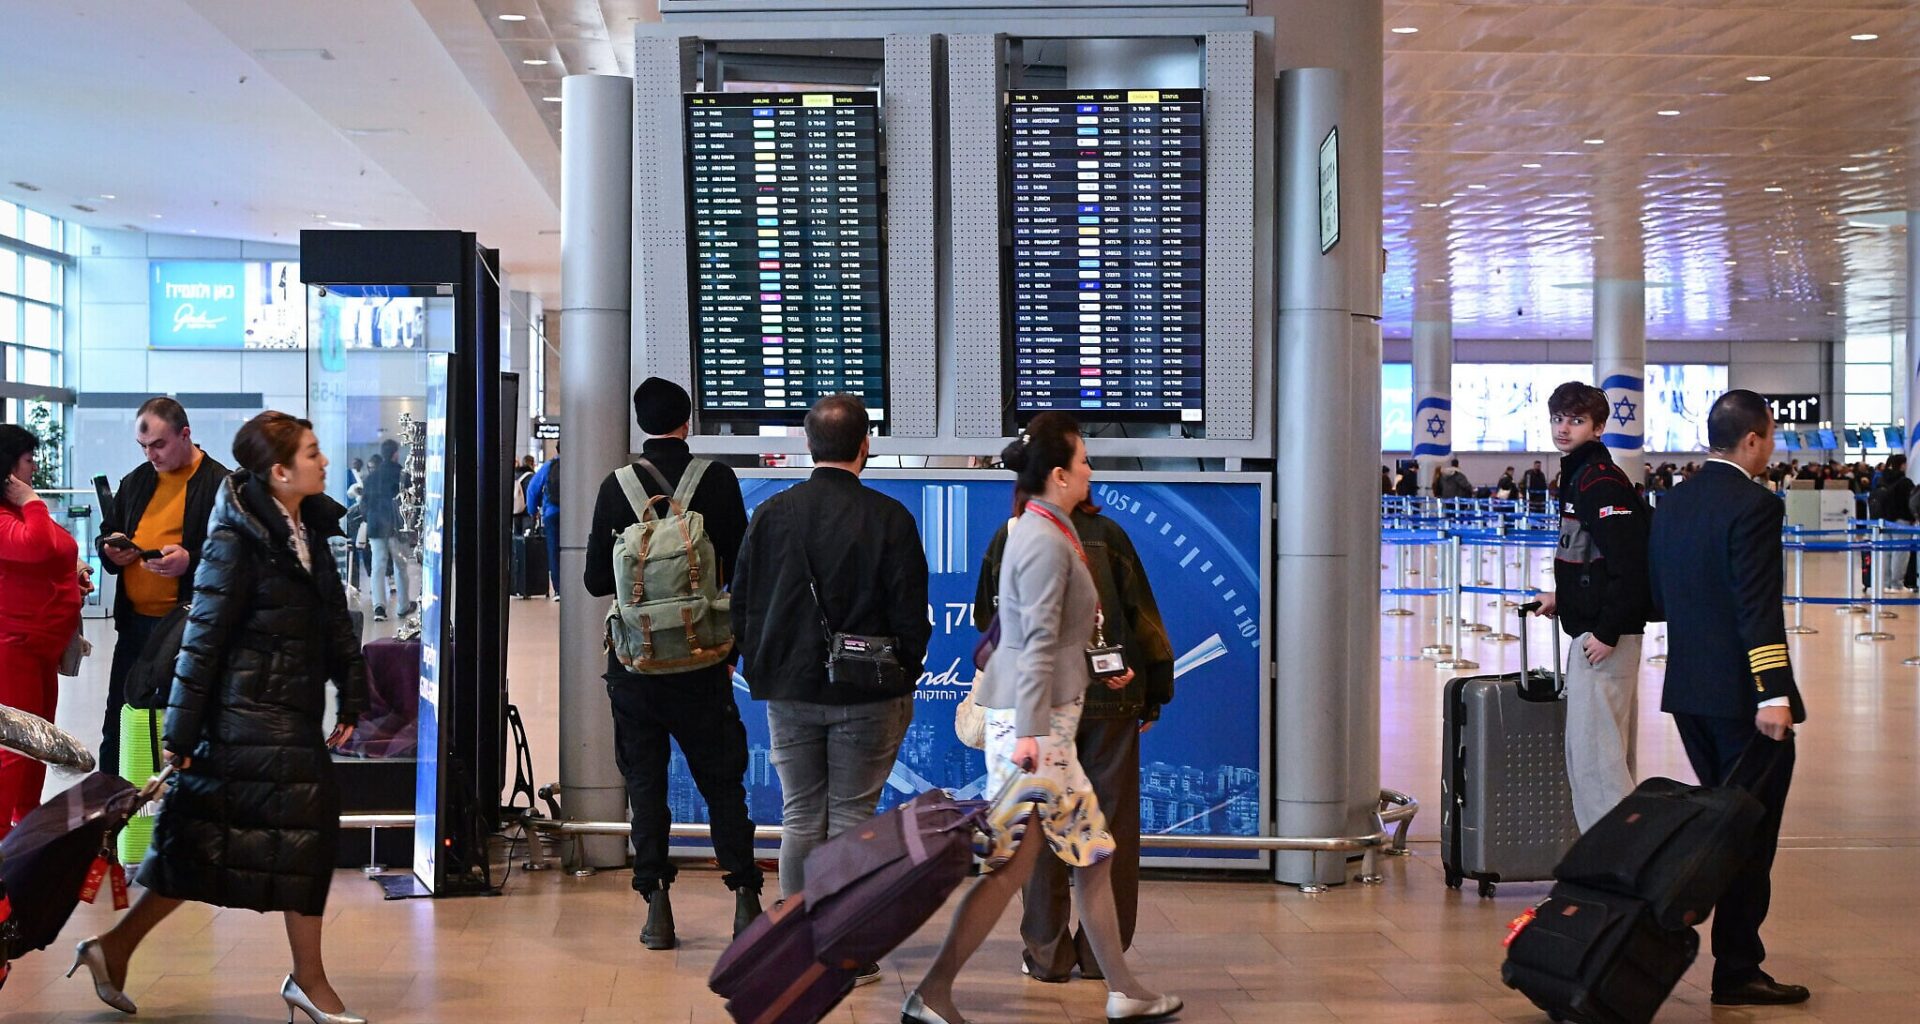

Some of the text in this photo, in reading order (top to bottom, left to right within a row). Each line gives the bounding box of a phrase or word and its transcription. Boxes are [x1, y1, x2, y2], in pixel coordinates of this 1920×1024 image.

[1106, 489, 1131, 511] 05
[1236, 618, 1257, 638] 10
[913, 690, 957, 702] החזקות
